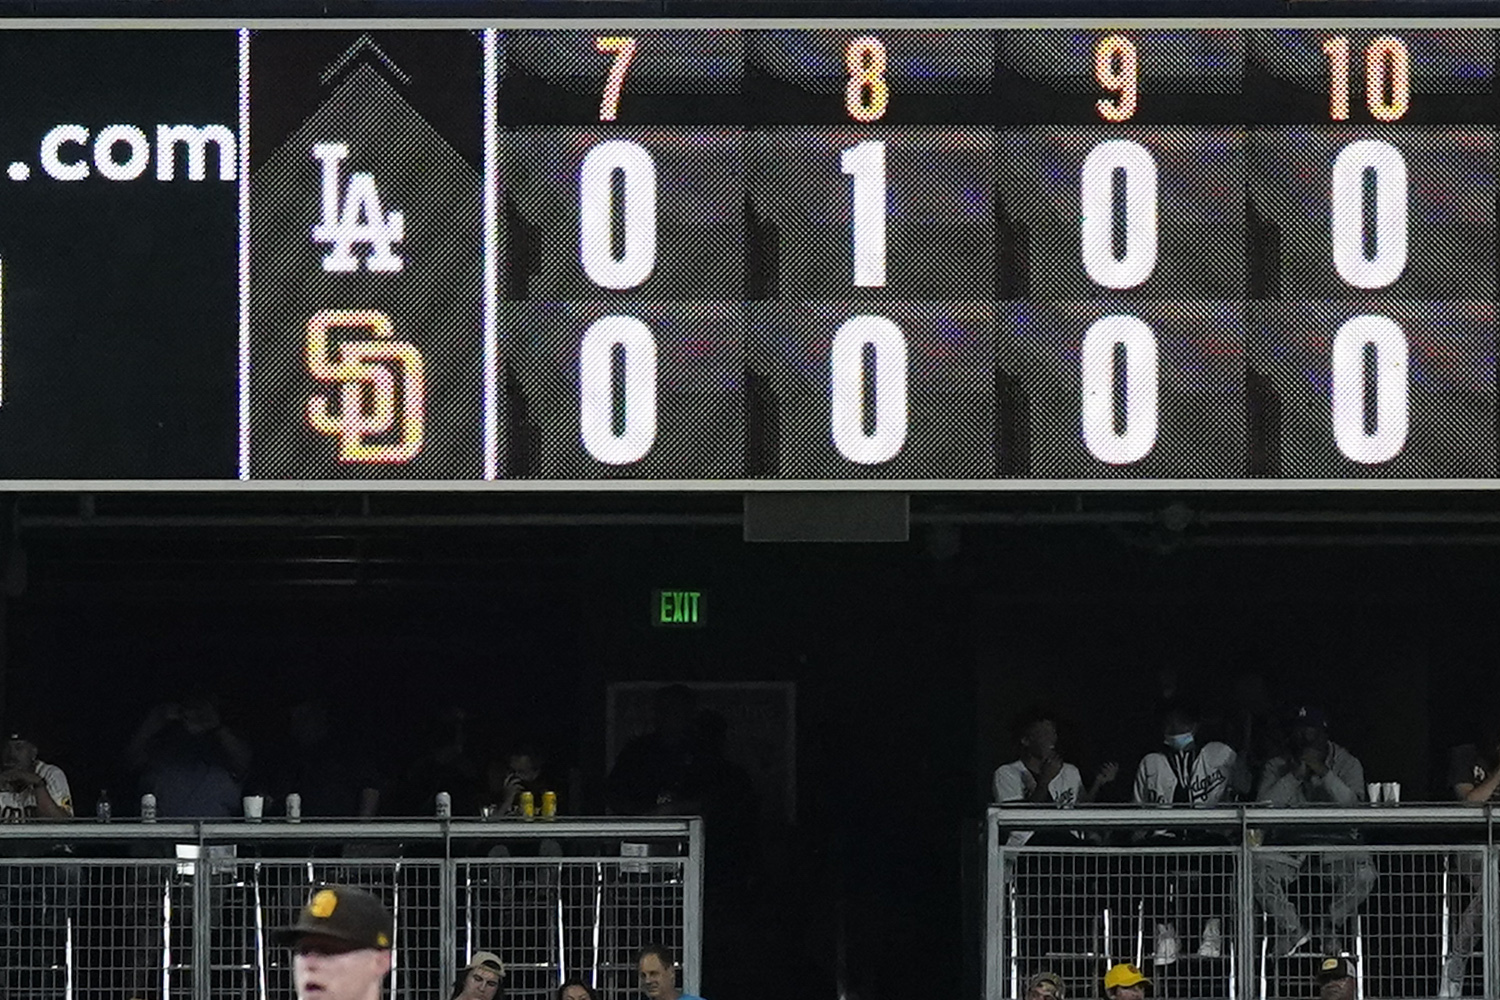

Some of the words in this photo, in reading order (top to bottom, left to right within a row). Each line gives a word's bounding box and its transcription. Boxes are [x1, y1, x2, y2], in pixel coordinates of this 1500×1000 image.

[595, 36, 636, 121] 7
[843, 36, 889, 122] 8
[1094, 36, 1139, 122] 9
[1322, 36, 1411, 122] 10
[7, 123, 238, 181] .com
[309, 142, 406, 273] LA
[580, 139, 657, 290] 0
[841, 139, 887, 287] 1
[1081, 139, 1158, 290] 0
[1332, 139, 1409, 290] 0
[305, 309, 426, 464] SD
[580, 314, 657, 466] 0
[831, 314, 909, 466] 0
[1081, 314, 1159, 466] 0
[1332, 314, 1410, 466] 0
[661, 592, 701, 622] EXIT
